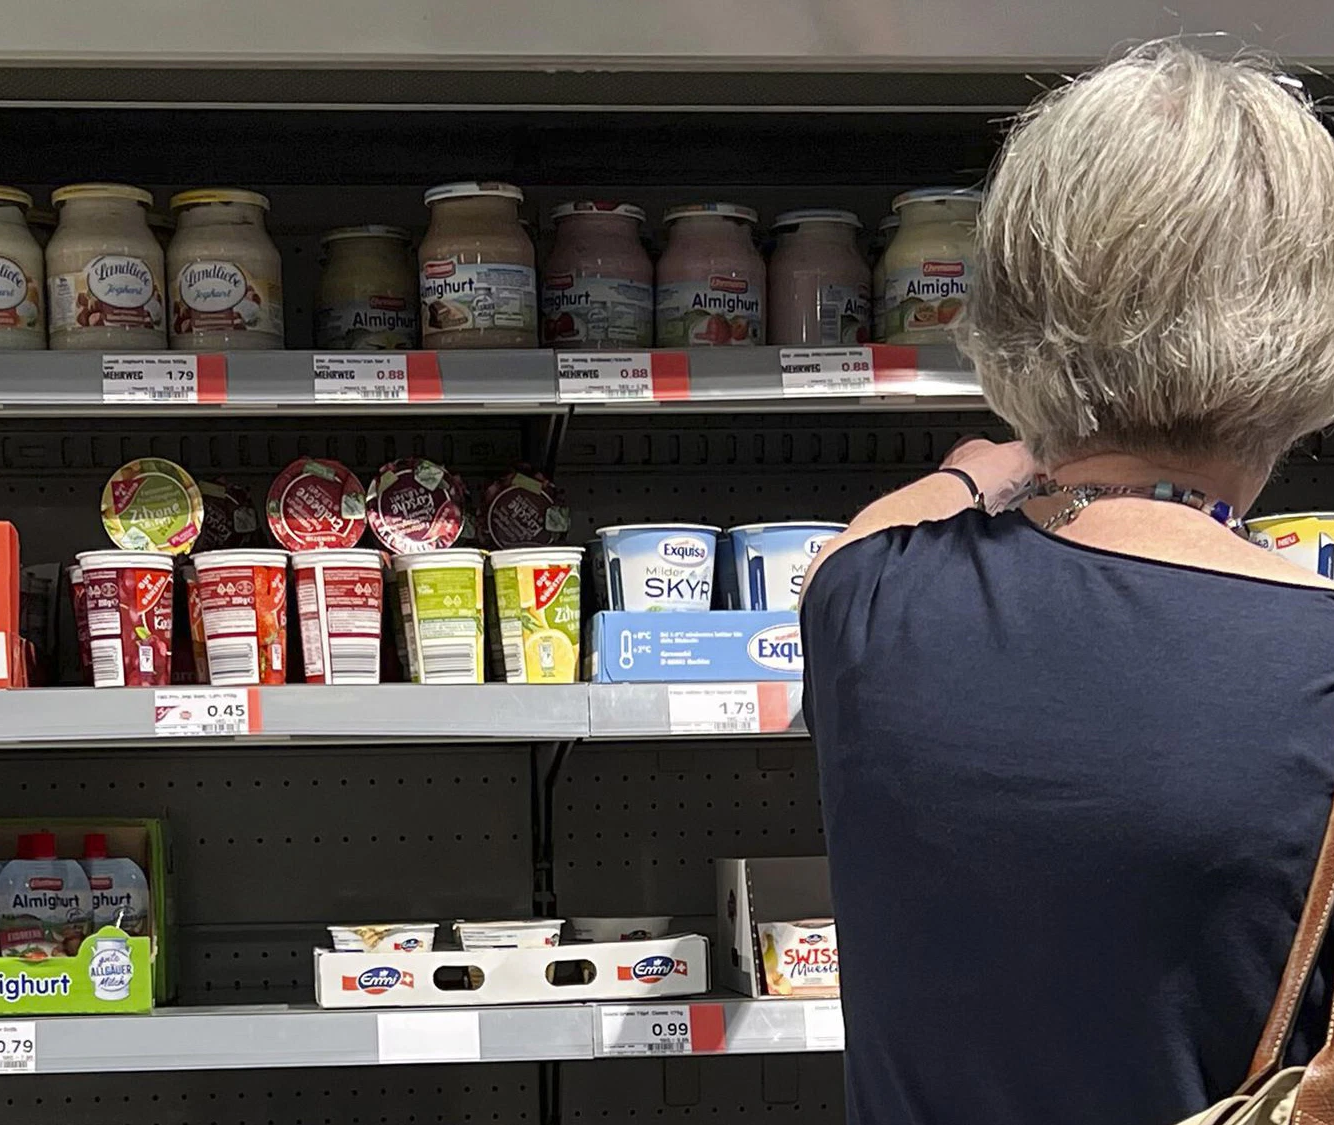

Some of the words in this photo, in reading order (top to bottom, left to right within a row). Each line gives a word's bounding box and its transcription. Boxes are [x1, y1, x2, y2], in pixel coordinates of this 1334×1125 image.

[906, 278, 967, 297] Almighu
[644, 578, 711, 601] SKYR
[757, 637, 804, 664] Exqu
[206, 703, 245, 717] 0.45
[718, 702, 756, 716] 1.79
[635, 960, 673, 978] Emmi
[651, 1022, 689, 1037] 0.99
